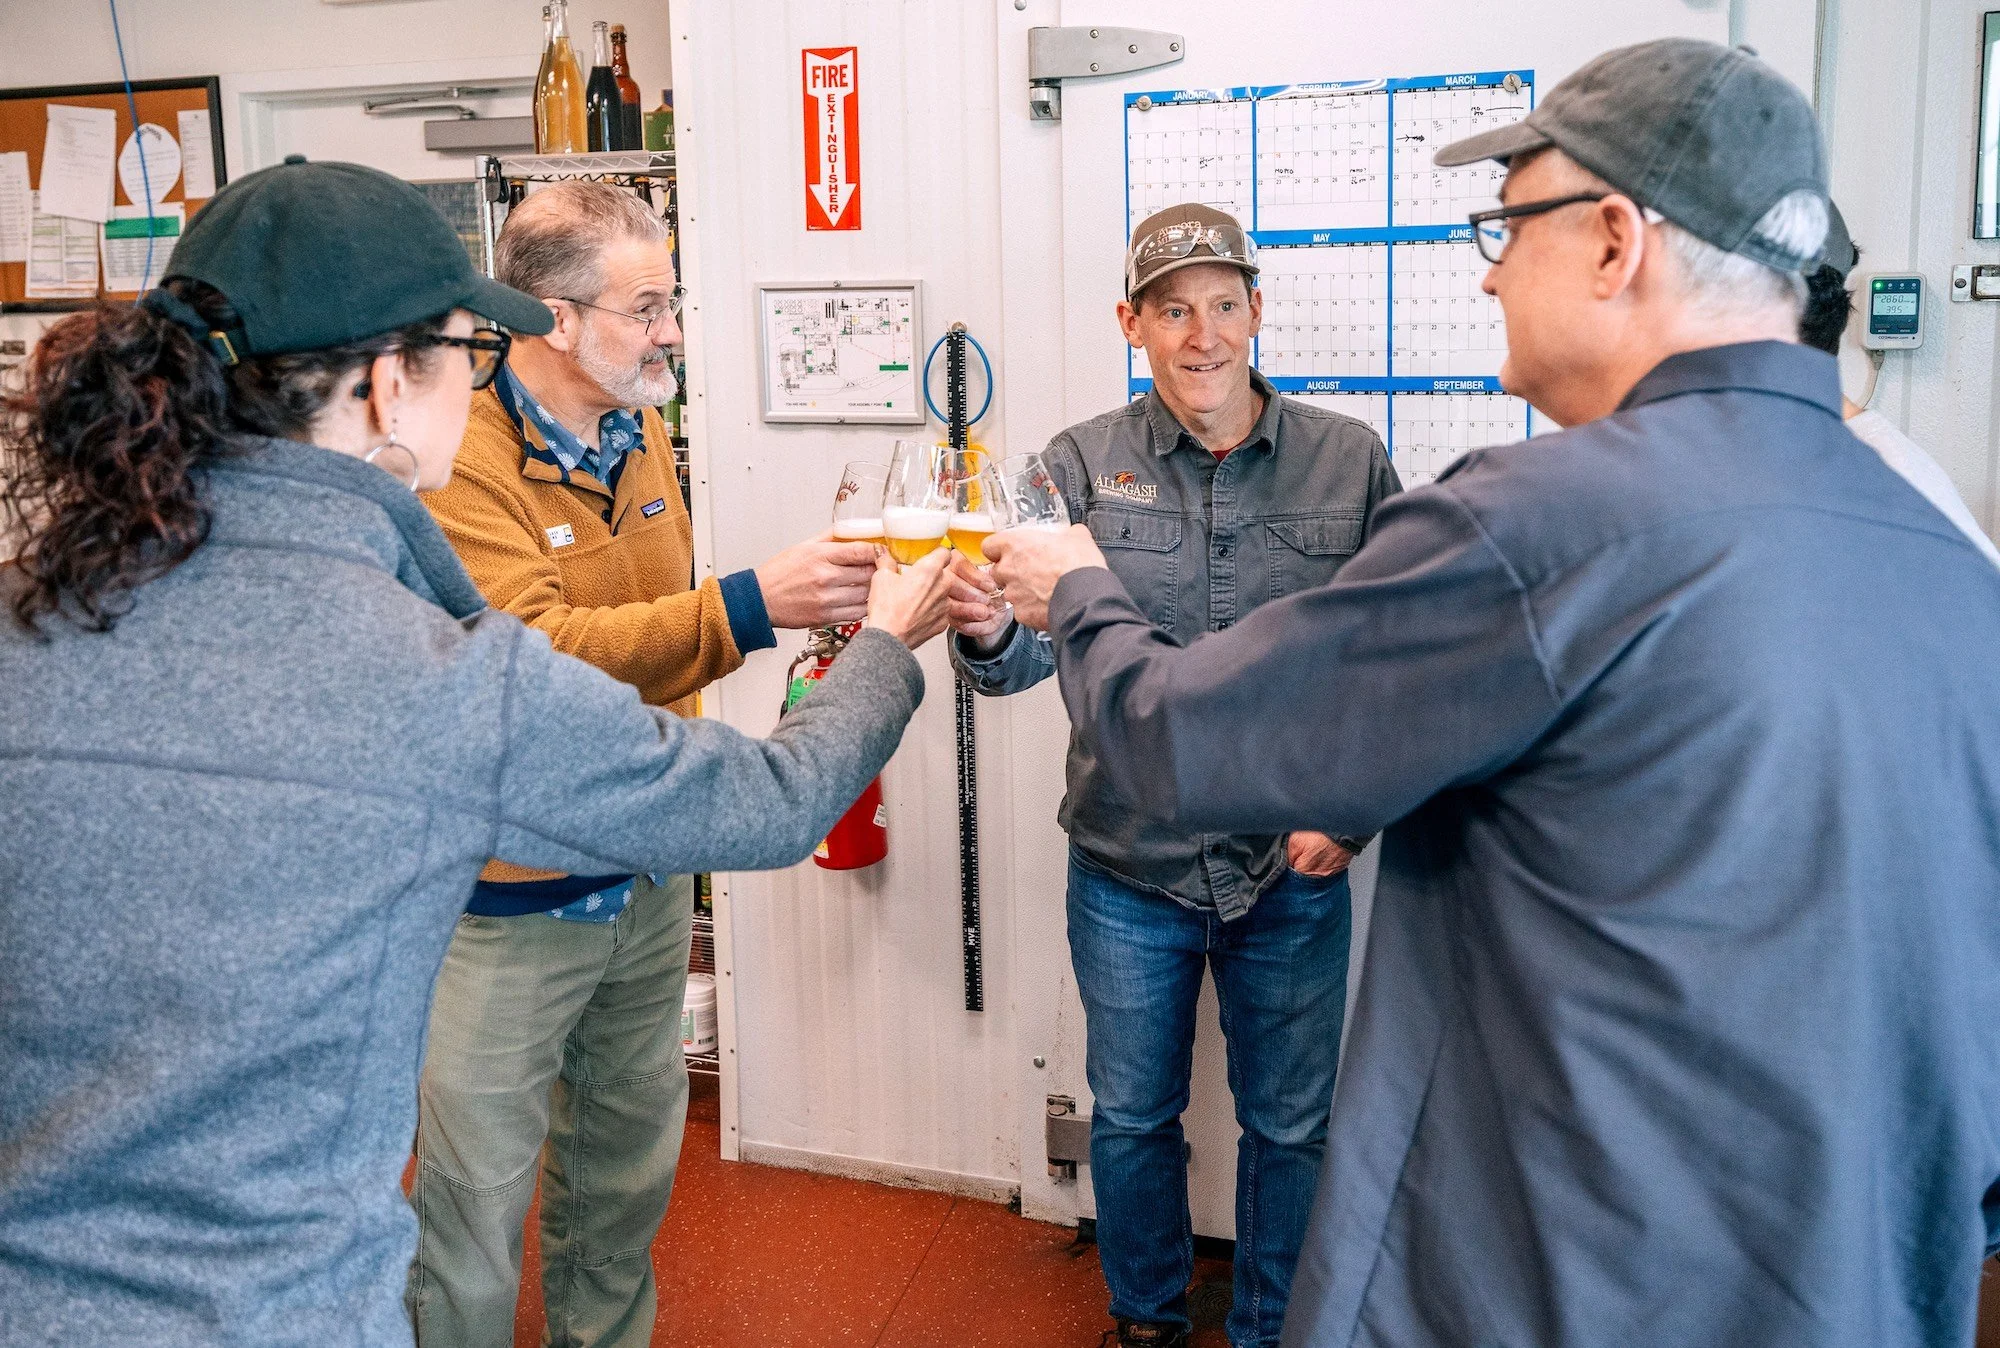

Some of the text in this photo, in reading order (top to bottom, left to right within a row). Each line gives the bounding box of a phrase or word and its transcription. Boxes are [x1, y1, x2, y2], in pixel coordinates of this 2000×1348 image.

[812, 64, 848, 88] FIRE
[1445, 76, 1476, 85] MARCH
[1172, 91, 1208, 100] JANUARY
[827, 94, 838, 213] EXTINGUISHER
[1313, 234, 1330, 242] MAY
[1448, 229, 1472, 238] JUNE
[1881, 295, 1904, 303] 2860
[1307, 381, 1340, 389] AUGUST
[1433, 381, 1484, 389] SEPTEMBER
[1094, 473, 1158, 497] ALLAGASH
[1098, 488, 1154, 504] BREWING COMPANY
